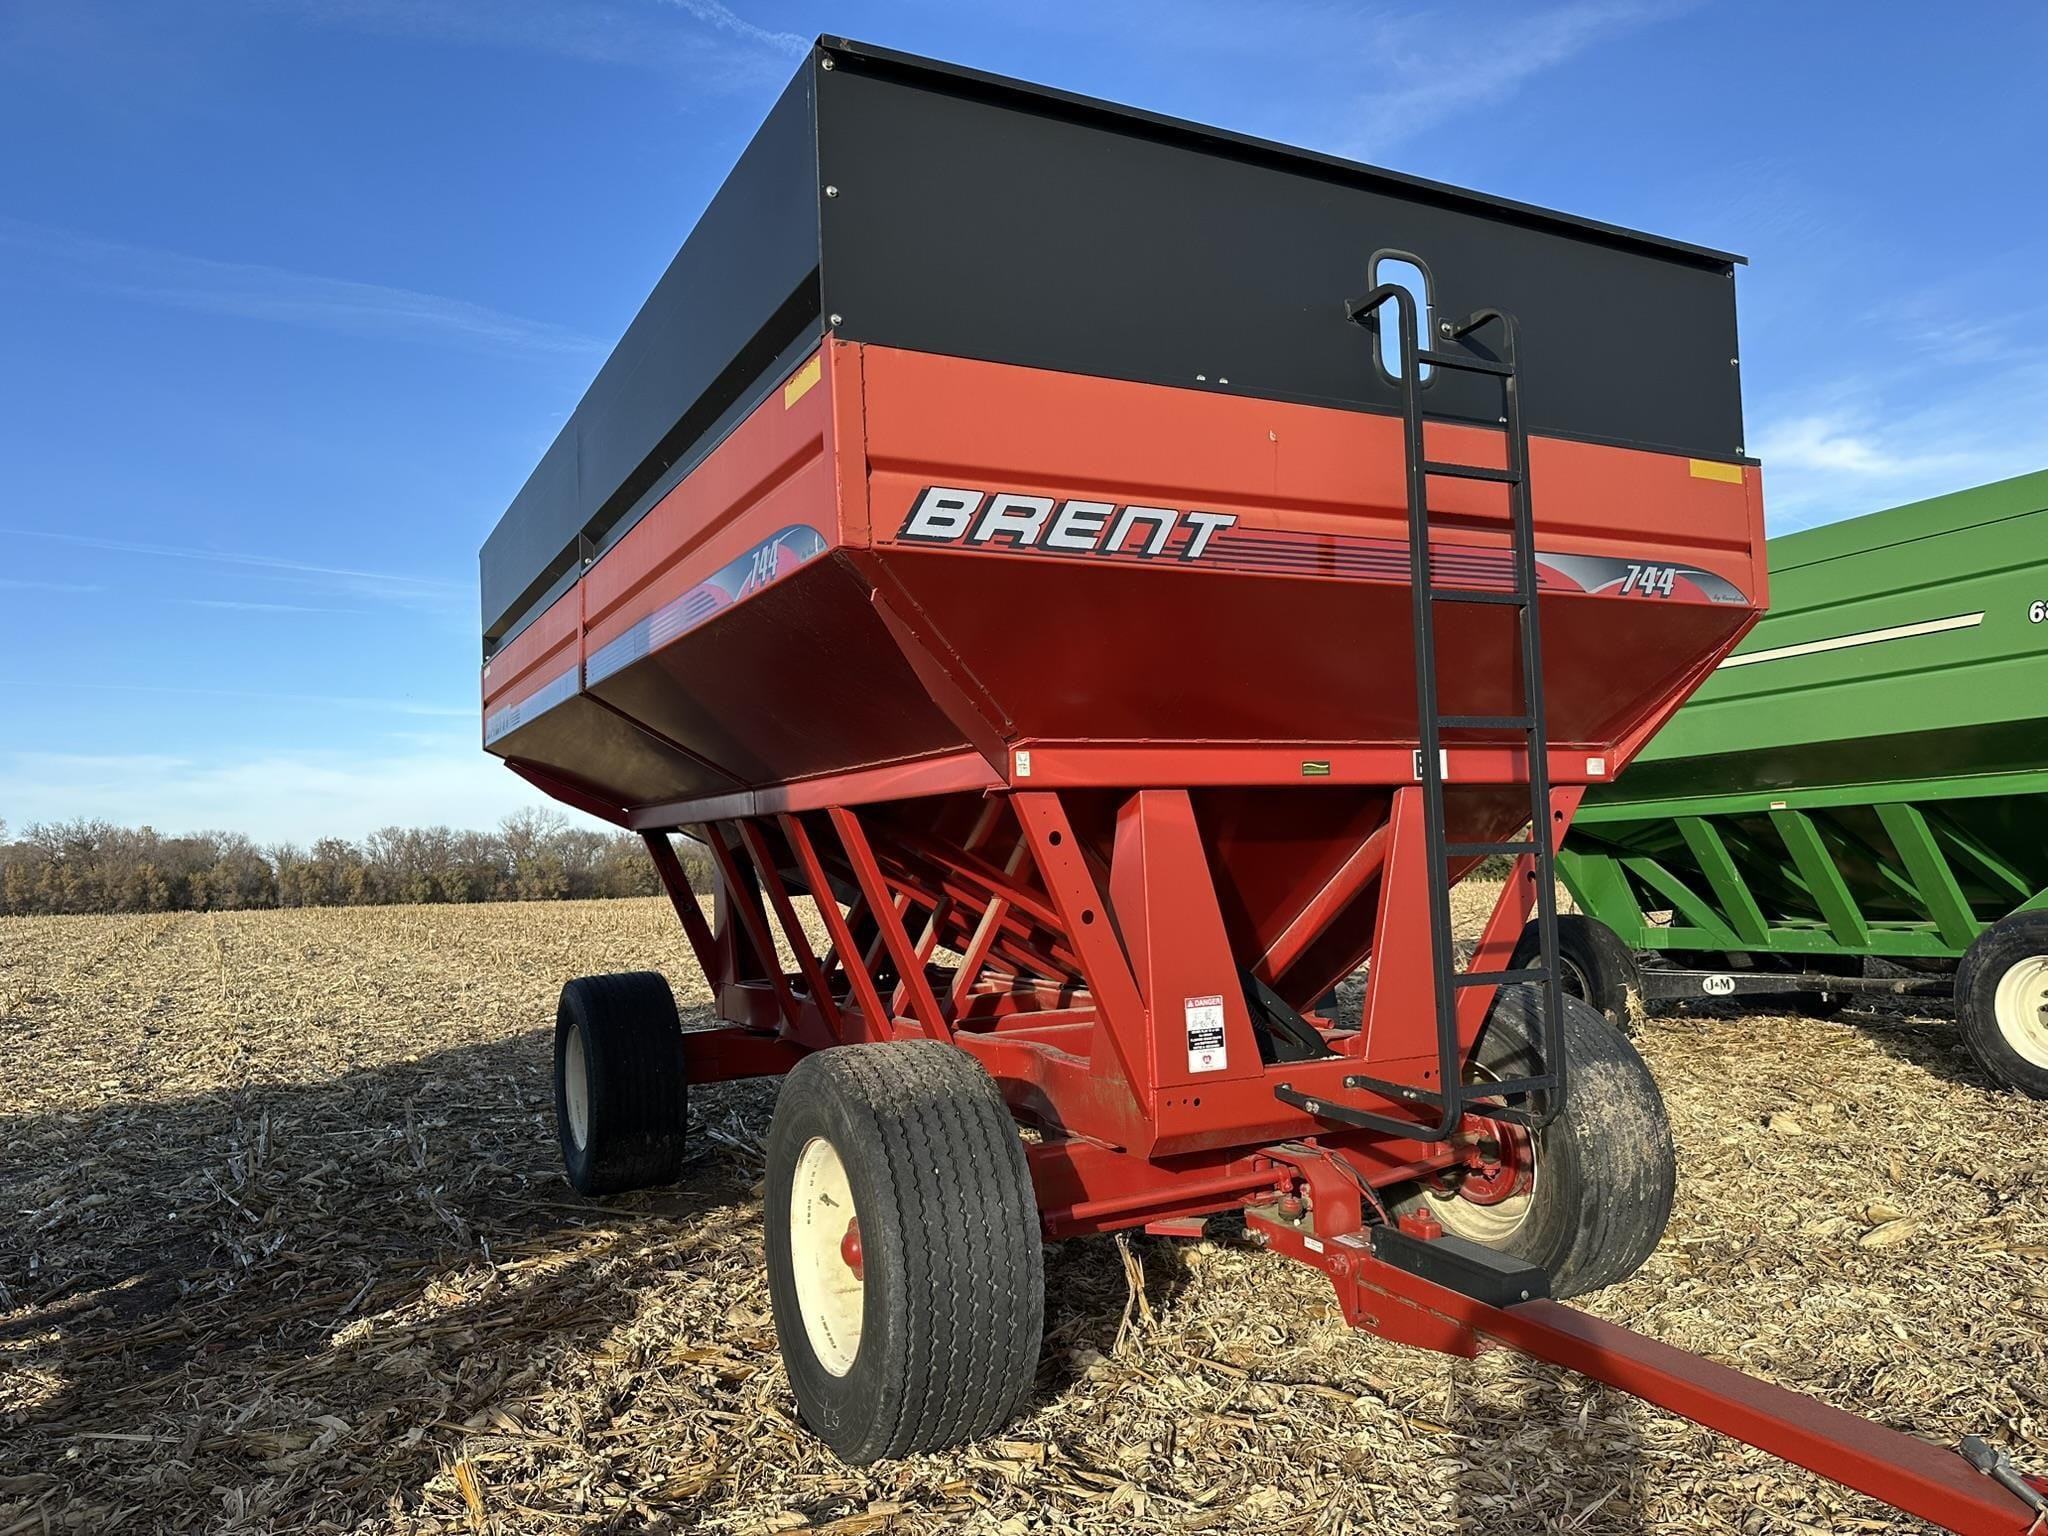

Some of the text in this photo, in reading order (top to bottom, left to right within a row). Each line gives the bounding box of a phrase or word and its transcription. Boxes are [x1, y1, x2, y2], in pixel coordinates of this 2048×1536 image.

[903, 485, 1237, 559] BRENT
[749, 538, 780, 590] 744
[1620, 564, 1676, 597] 744
[2028, 600, 2048, 624] 6
[1705, 978, 1731, 991] J&M
[1194, 997, 1221, 1007] DANGER
